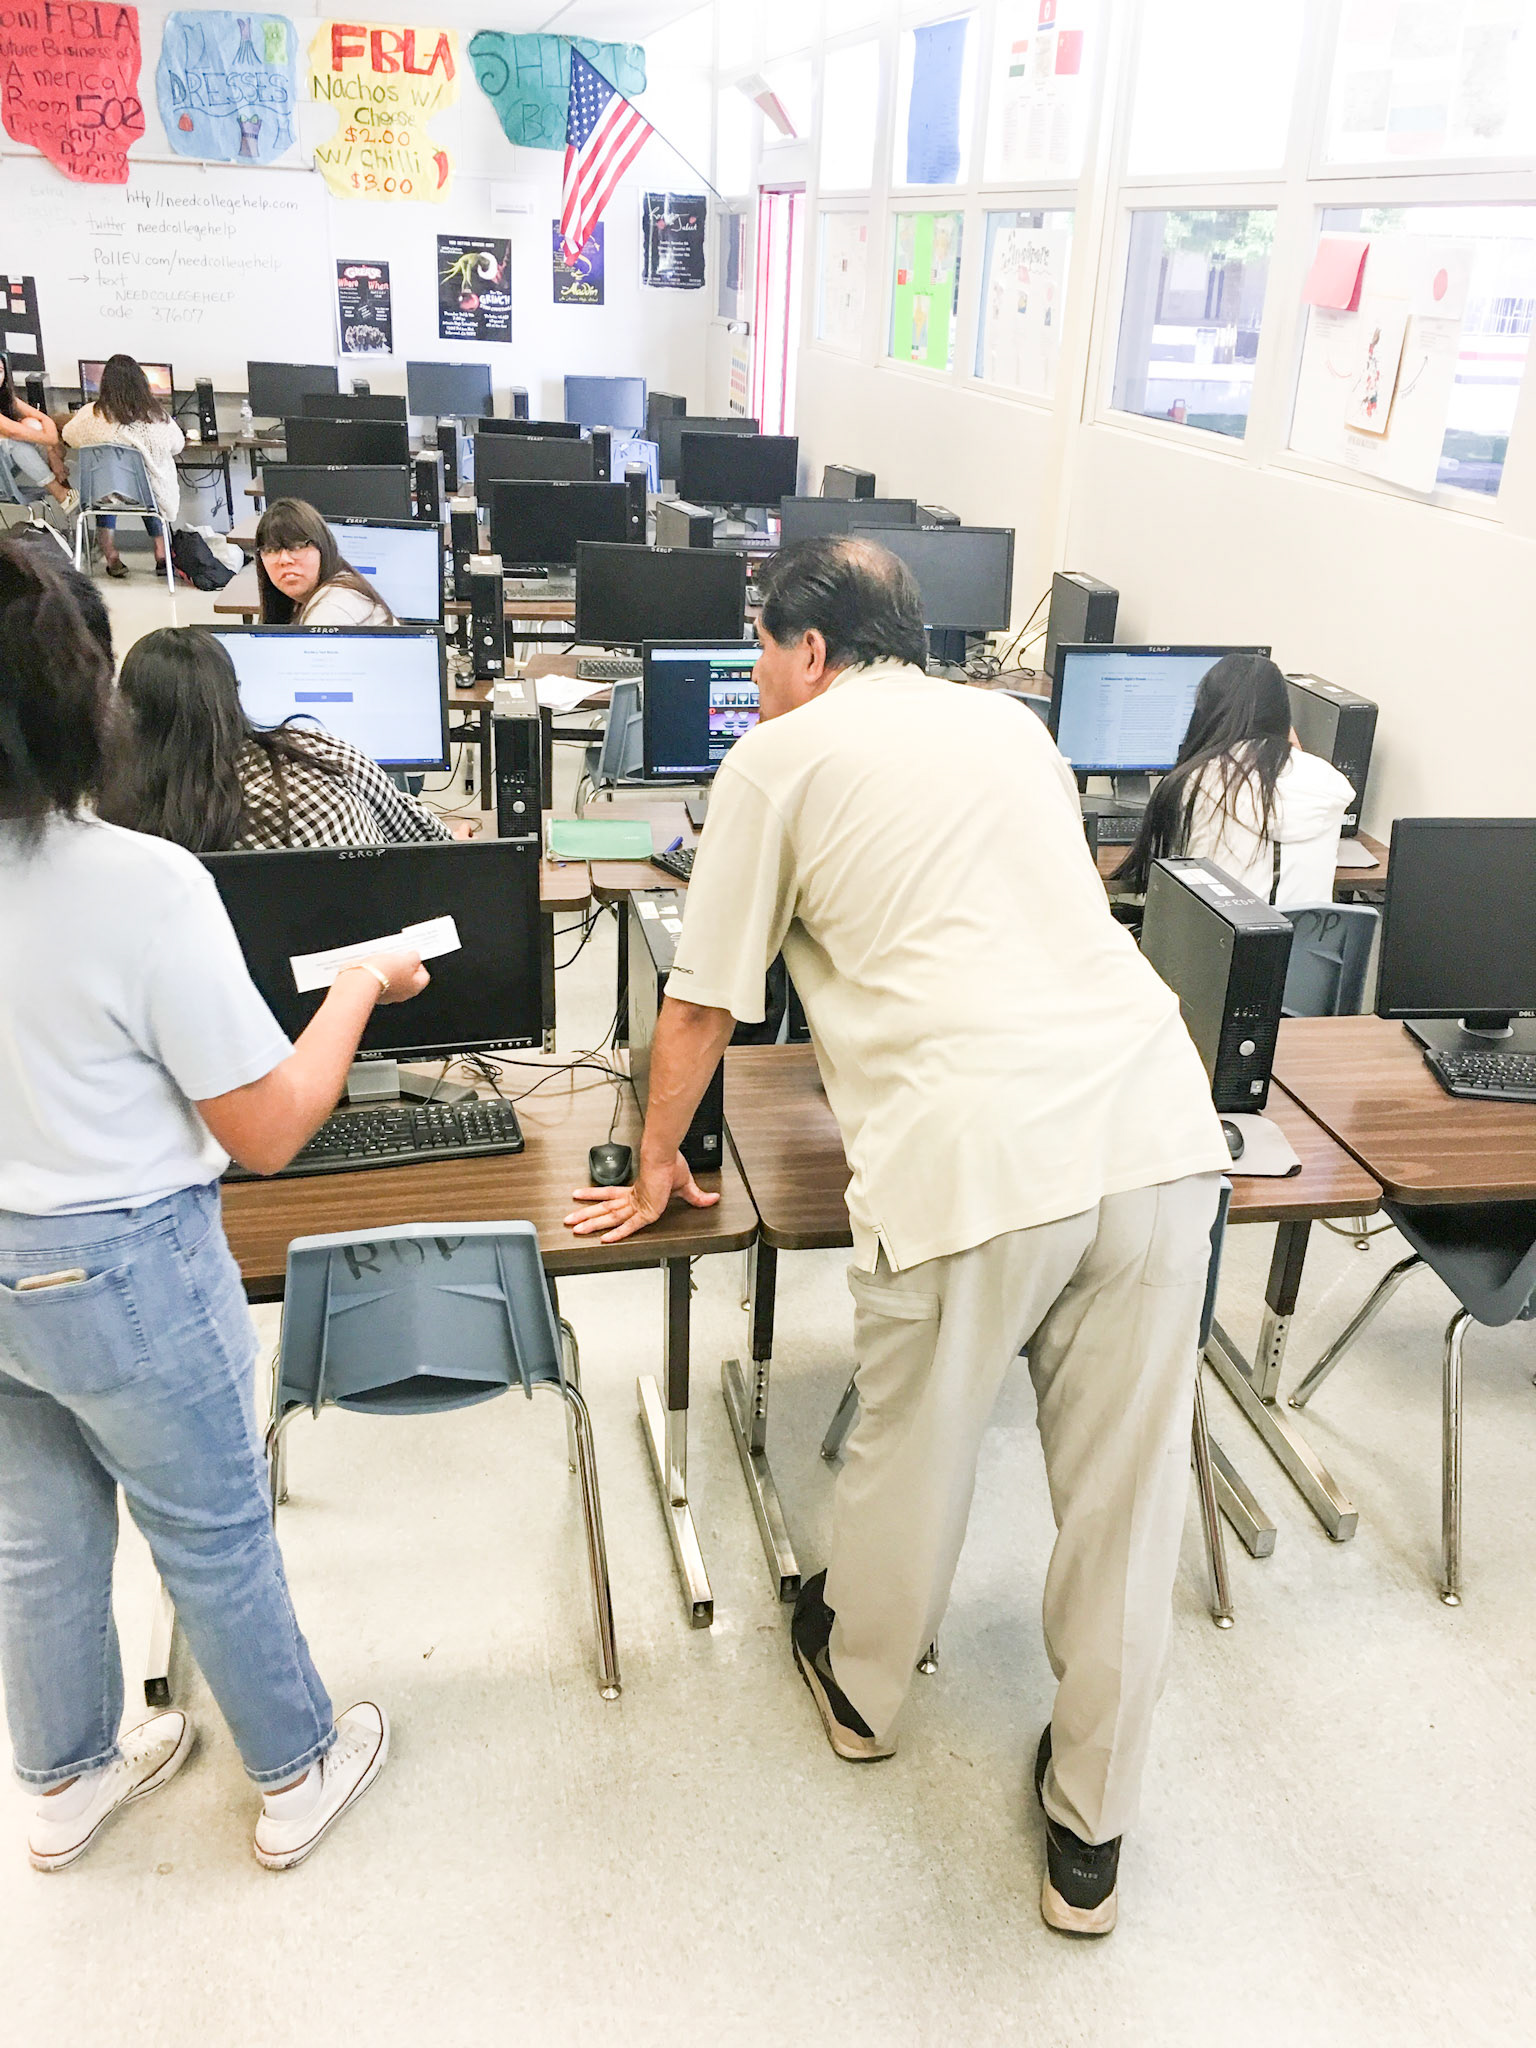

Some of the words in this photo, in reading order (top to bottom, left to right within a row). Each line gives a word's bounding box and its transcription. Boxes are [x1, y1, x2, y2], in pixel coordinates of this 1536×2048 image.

[0, 10, 38, 31] oin
[0, 38, 39, 58] uture
[331, 23, 455, 81] FBLA
[167, 69, 289, 108] DRESSES
[313, 74, 399, 104] Nachos
[8, 85, 70, 117] Room
[76, 94, 144, 131] 502
[344, 126, 410, 147] $2.00
[360, 149, 420, 174] Chilli
[351, 171, 413, 194] $3.00
[137, 219, 237, 241] needcollegehelp
[309, 626, 340, 635] SEROP
[338, 848, 386, 861] SEROP
[1295, 909, 1342, 942] OP
[342, 1236, 466, 1281] ROP
